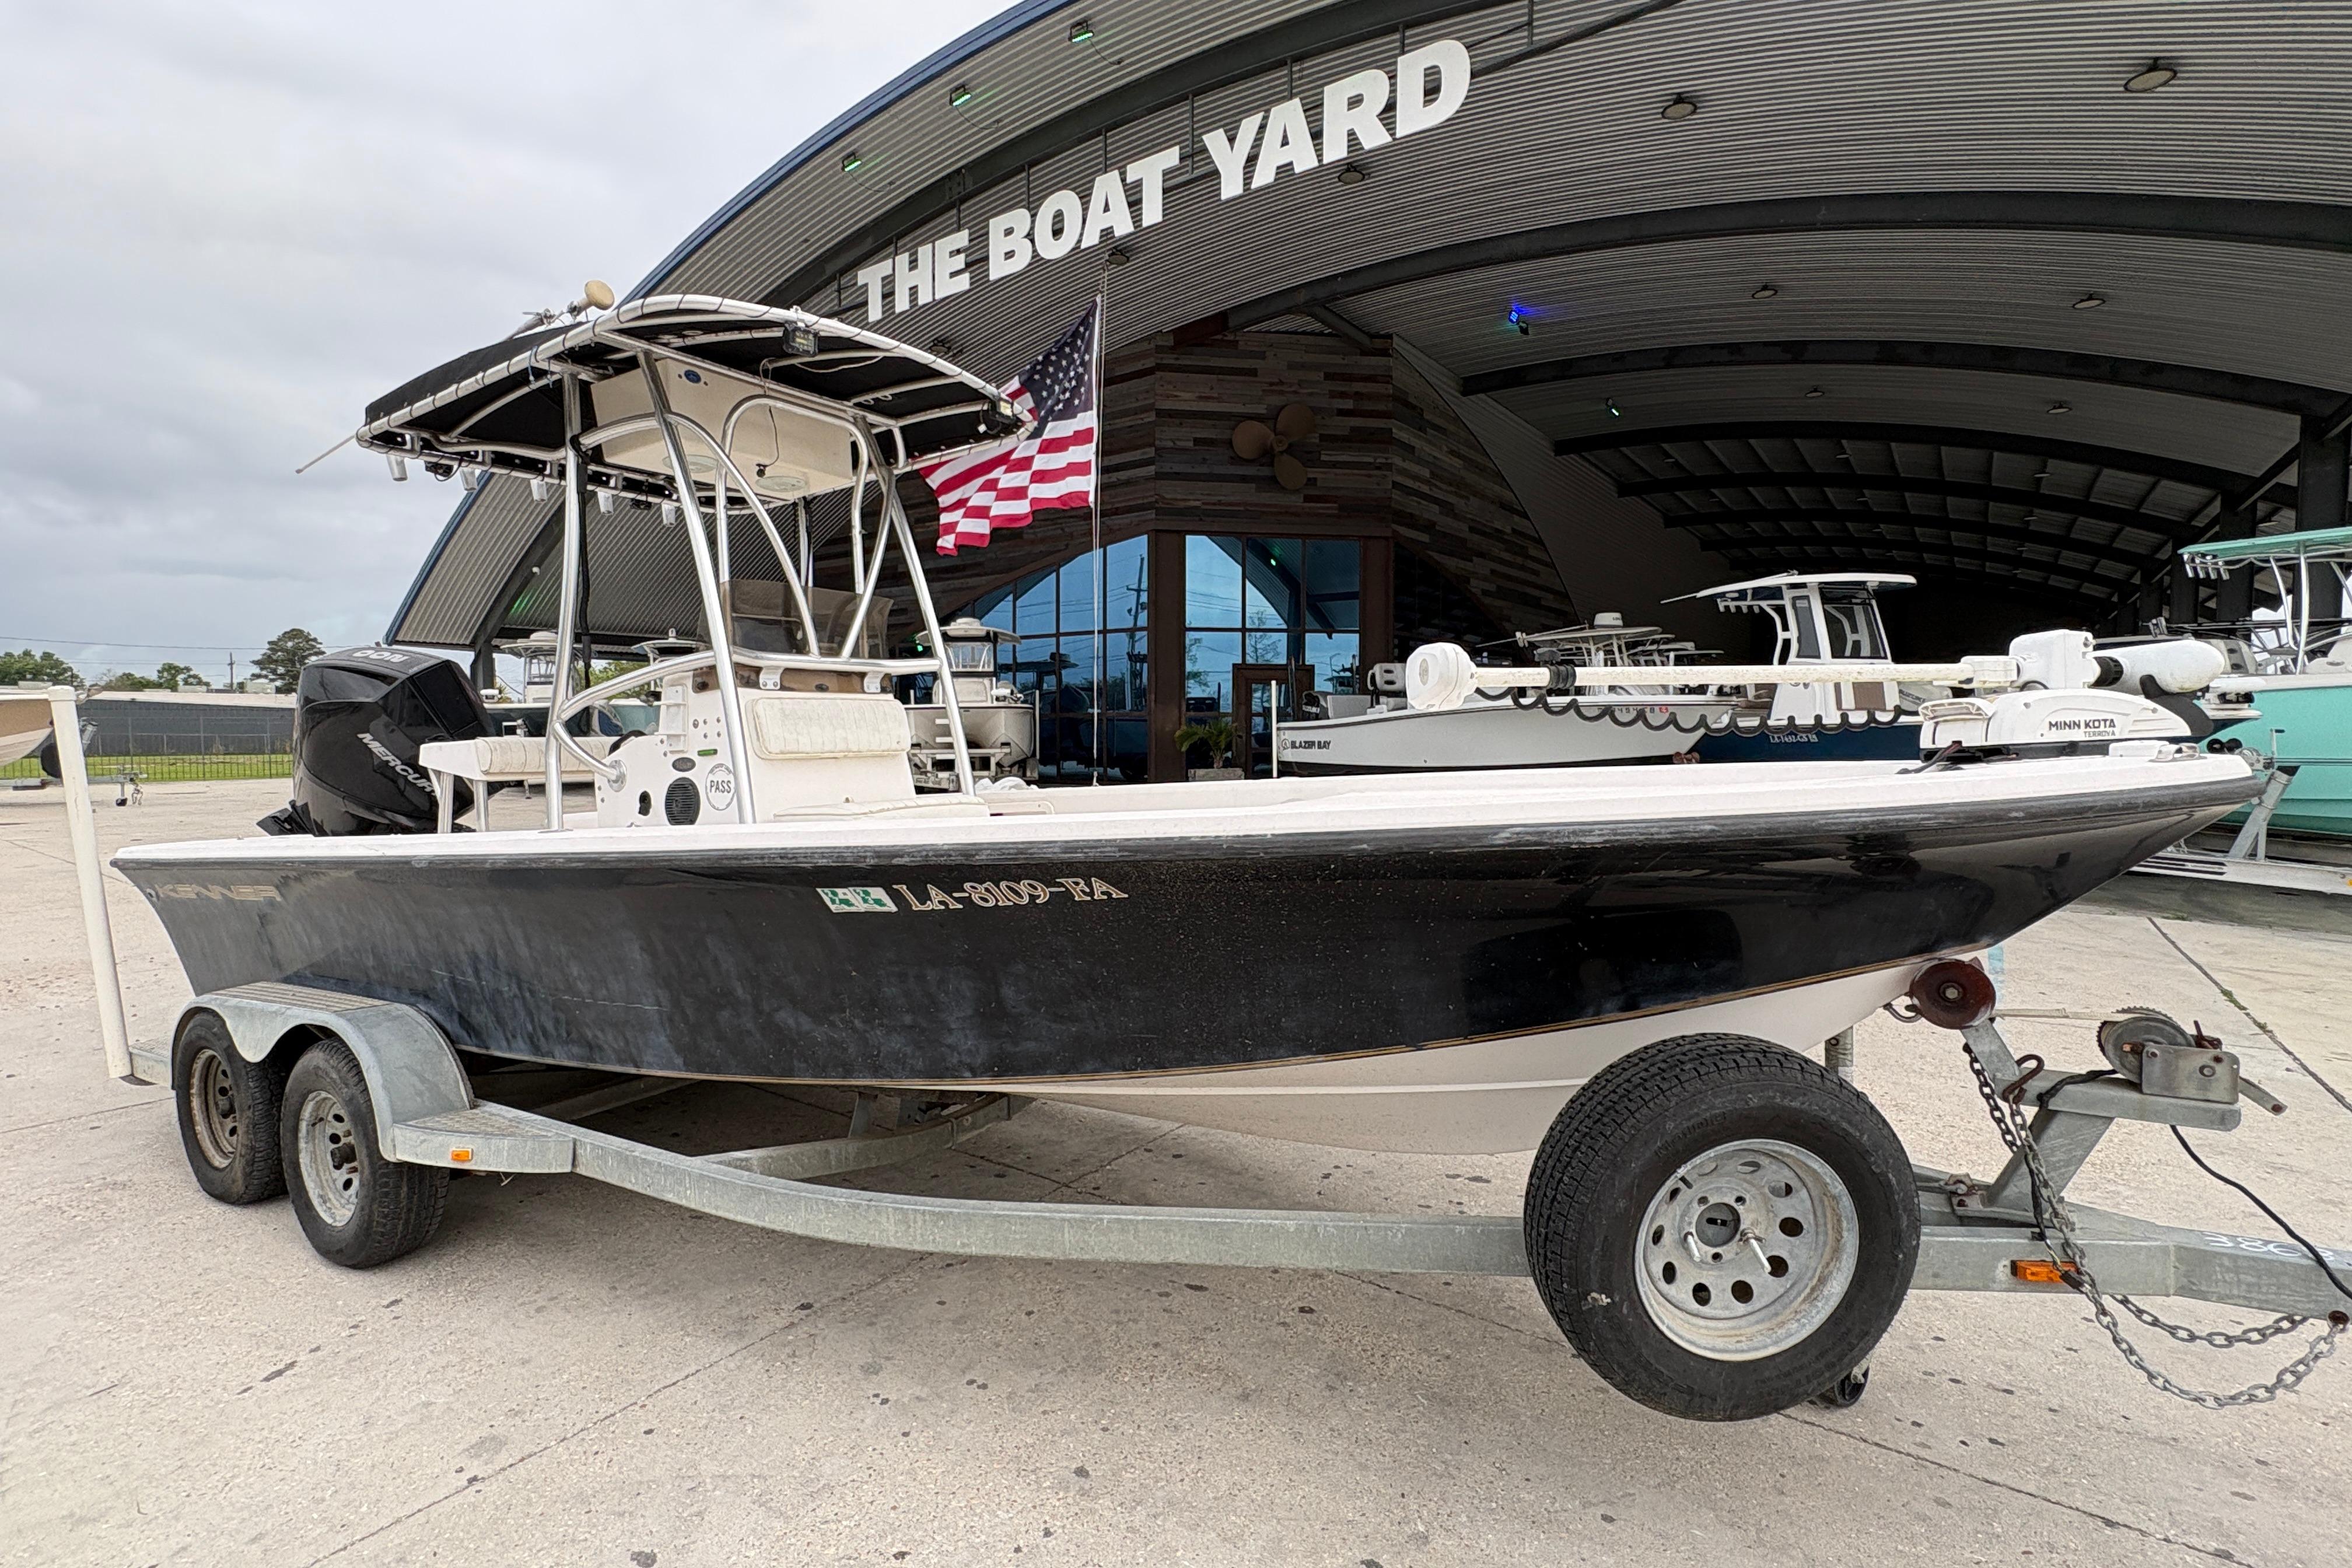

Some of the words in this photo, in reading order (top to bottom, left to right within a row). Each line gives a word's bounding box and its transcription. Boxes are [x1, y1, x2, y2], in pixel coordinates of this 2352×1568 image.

[858, 229, 970, 321] THE
[989, 145, 1180, 281] BOAT
[1202, 39, 1471, 200] YARD
[2049, 719, 2081, 730] MINN
[2084, 718, 2116, 729] KOTA
[1290, 740, 1315, 750] BLAZER
[1317, 740, 1331, 750] BAY
[356, 733, 436, 796] MERCUR
[709, 780, 732, 793] PASS
[155, 884, 281, 901] KENNER
[892, 877, 1128, 911] LA-8109-FA
